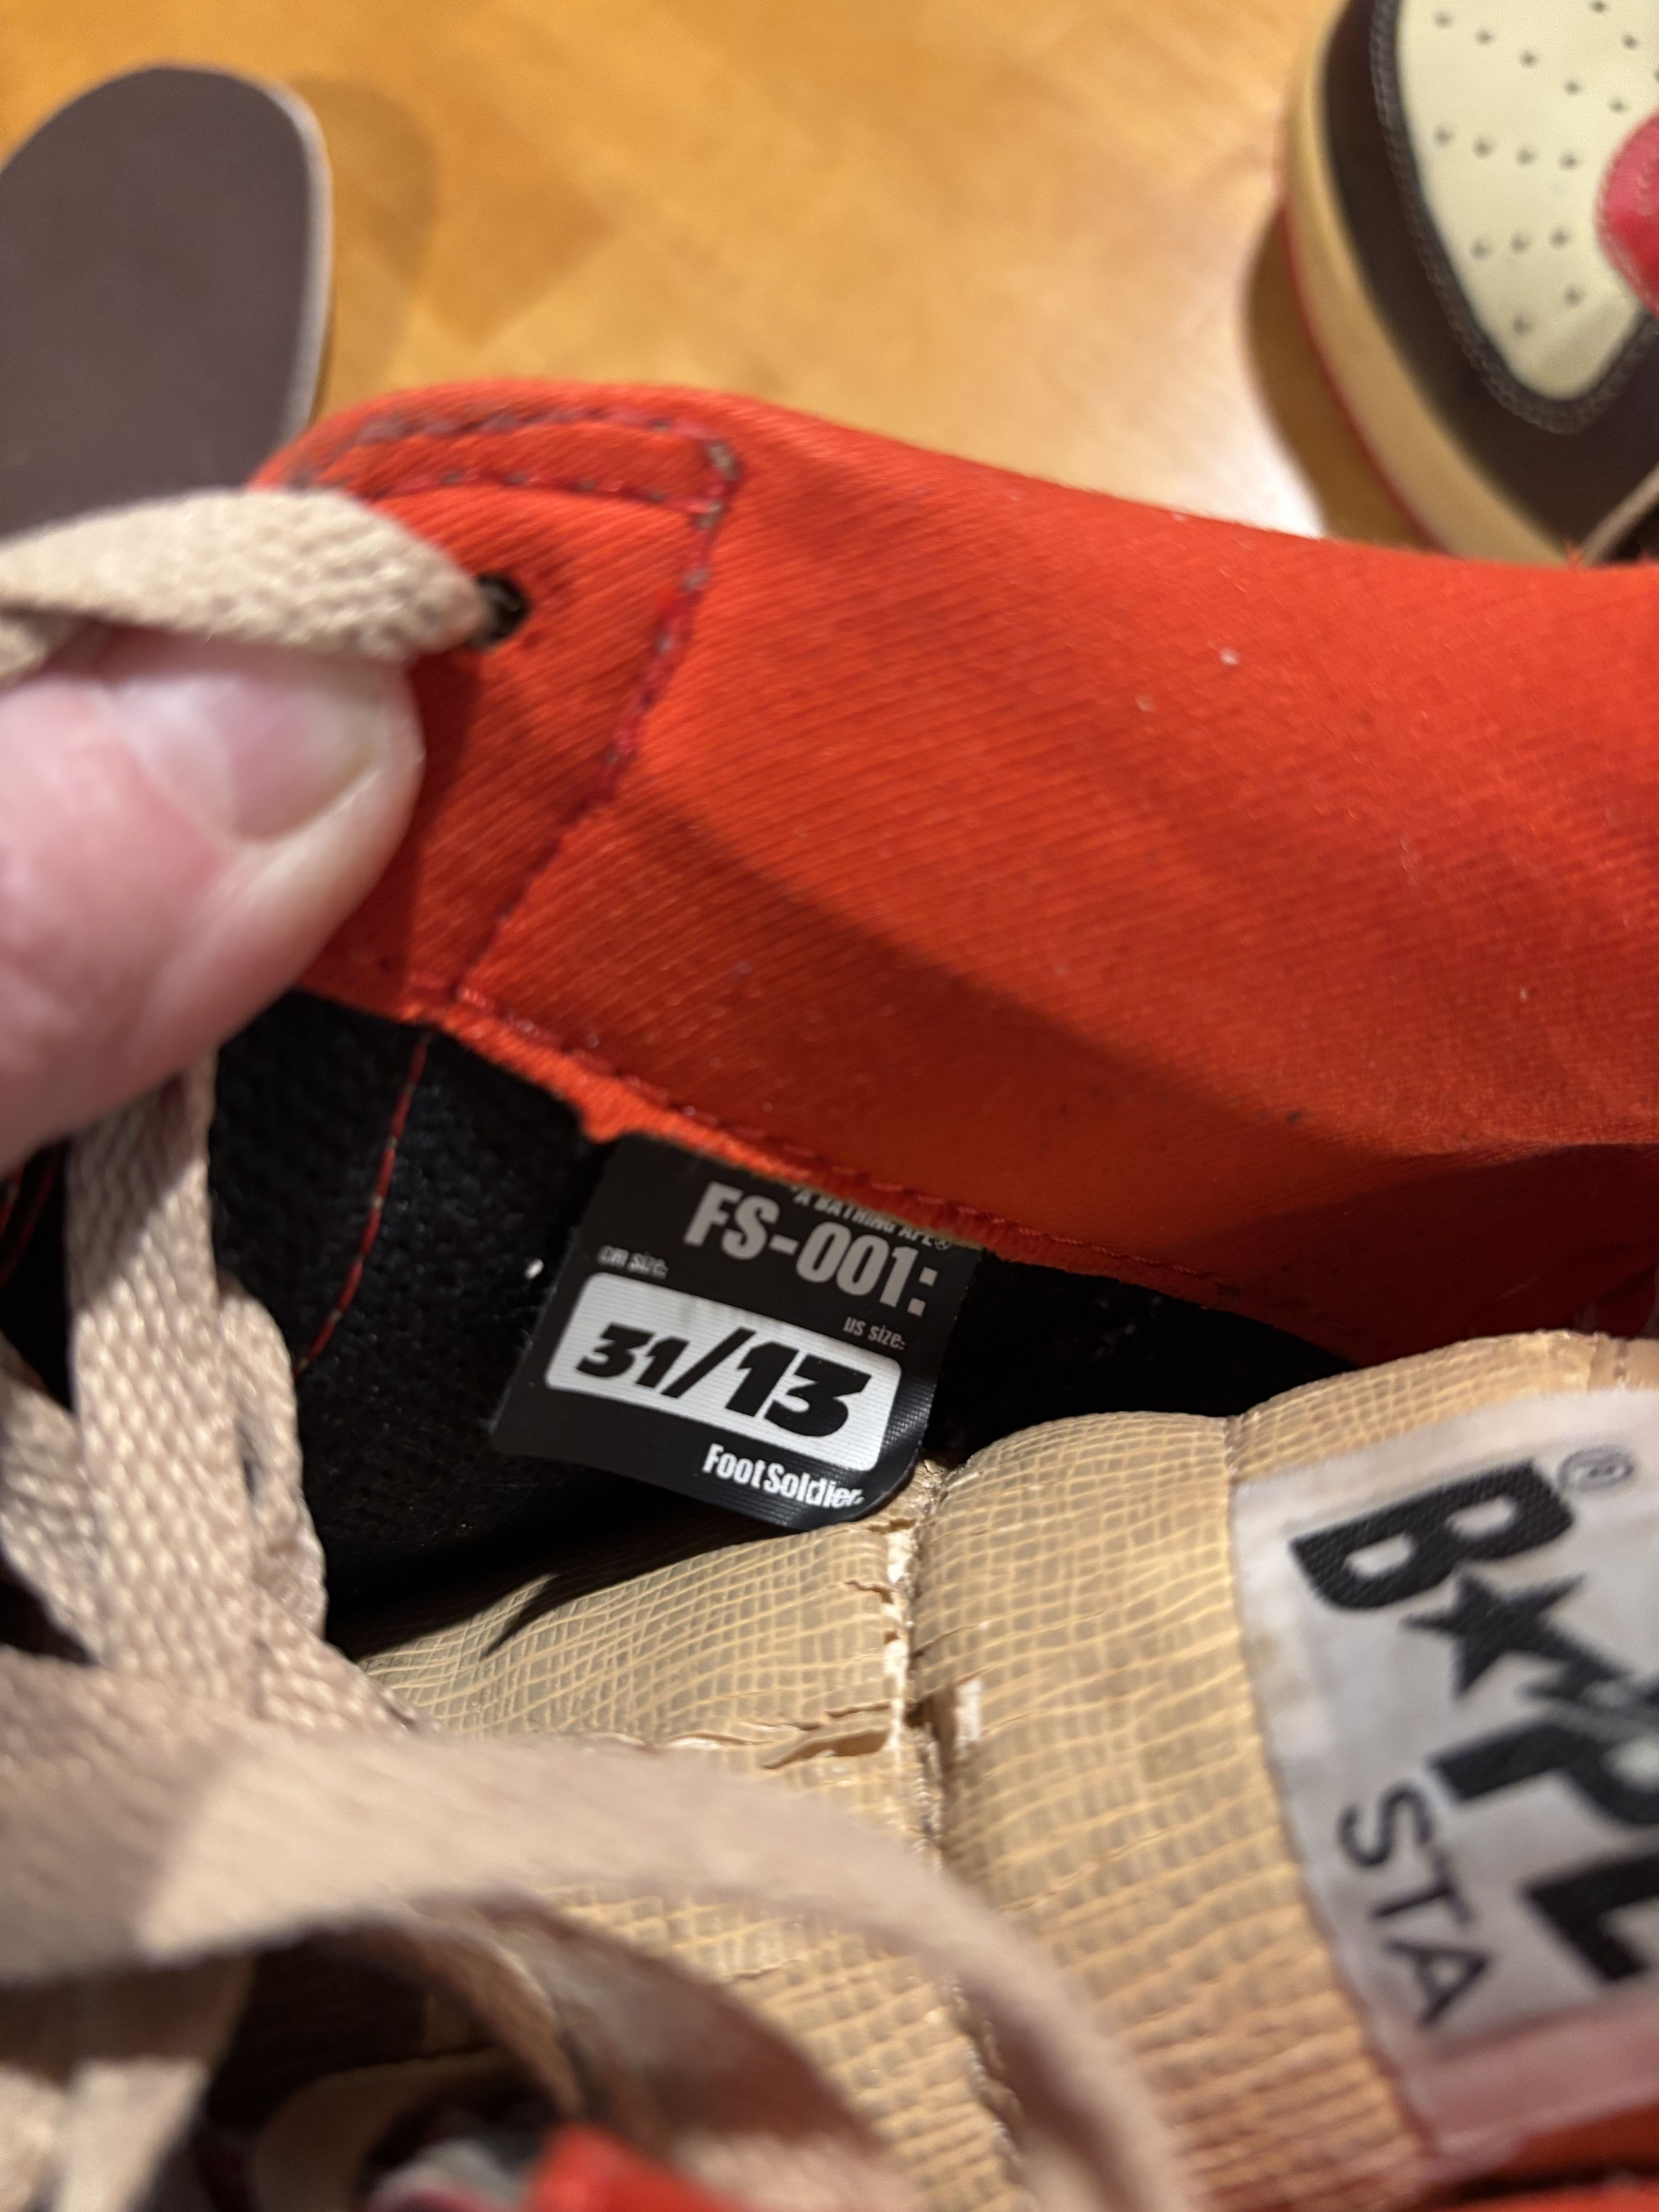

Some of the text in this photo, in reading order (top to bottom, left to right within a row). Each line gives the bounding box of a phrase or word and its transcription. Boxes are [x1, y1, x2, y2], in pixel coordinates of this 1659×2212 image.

[684, 1181, 938, 1317] FS-001:
[867, 1324, 906, 1350] size:
[1339, 1781, 1491, 2026] STA
